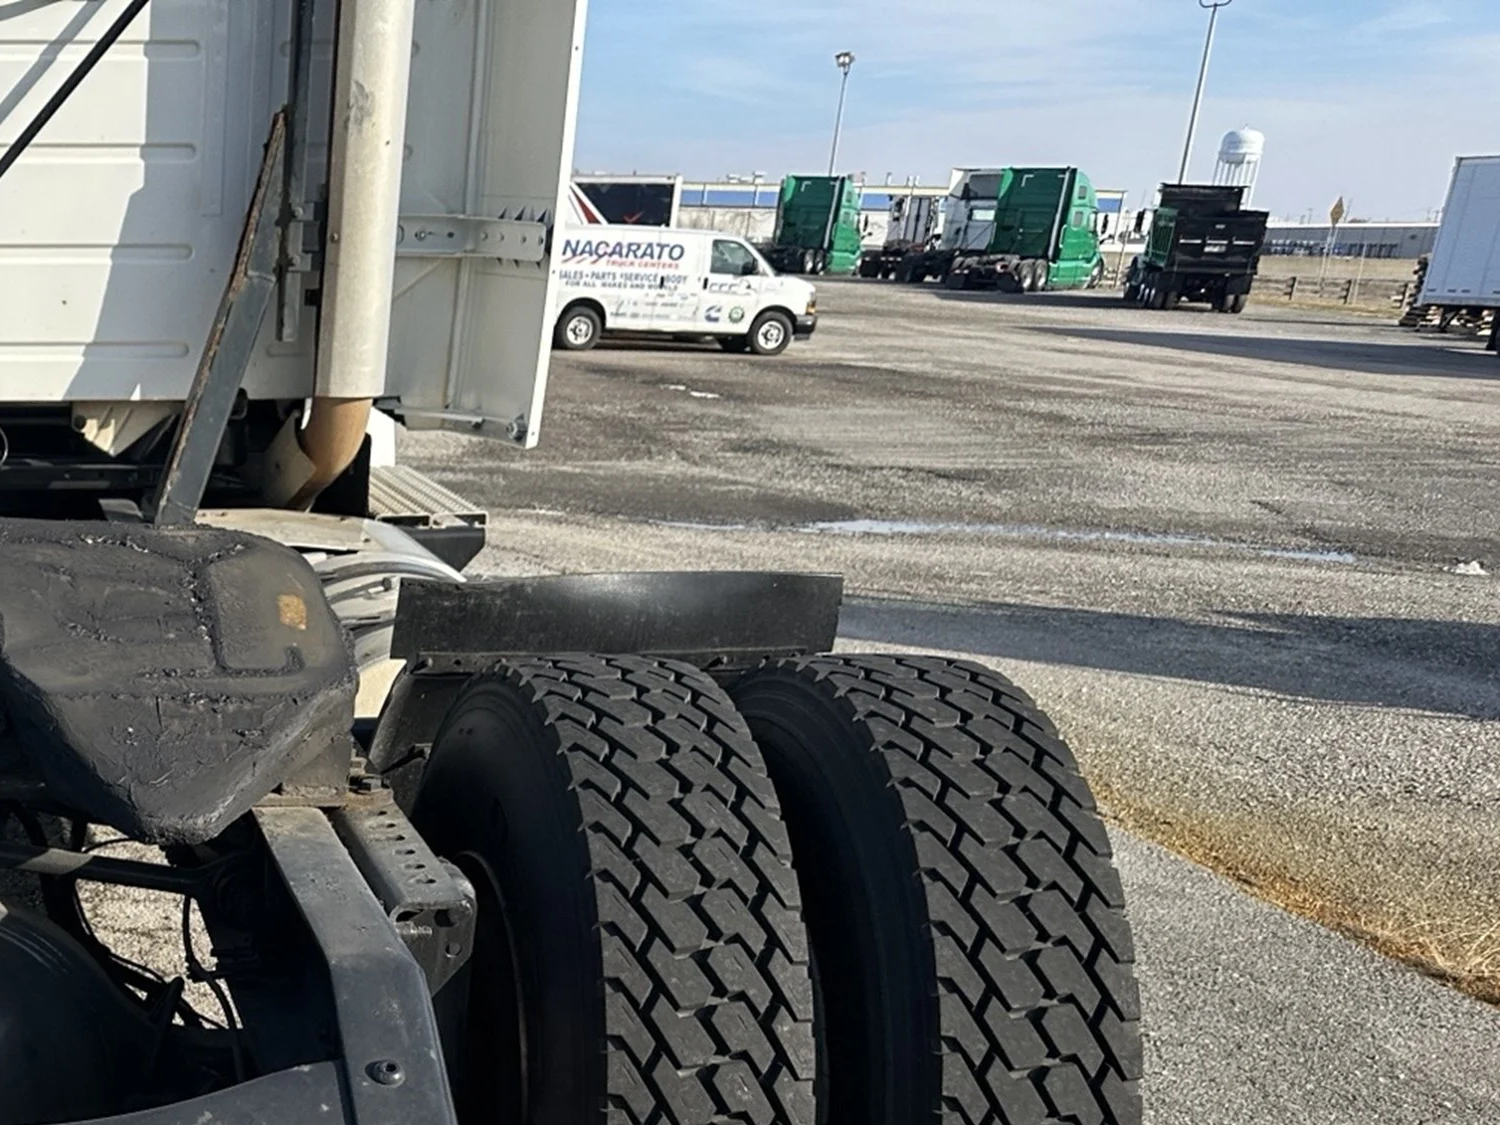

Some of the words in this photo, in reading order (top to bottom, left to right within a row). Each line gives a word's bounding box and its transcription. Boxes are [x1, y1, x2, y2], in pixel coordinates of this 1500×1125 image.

[561, 239, 685, 261] NACARATO
[559, 270, 584, 280] SALES
[590, 271, 617, 281] PARTS
[623, 272, 658, 283] SERVICE
